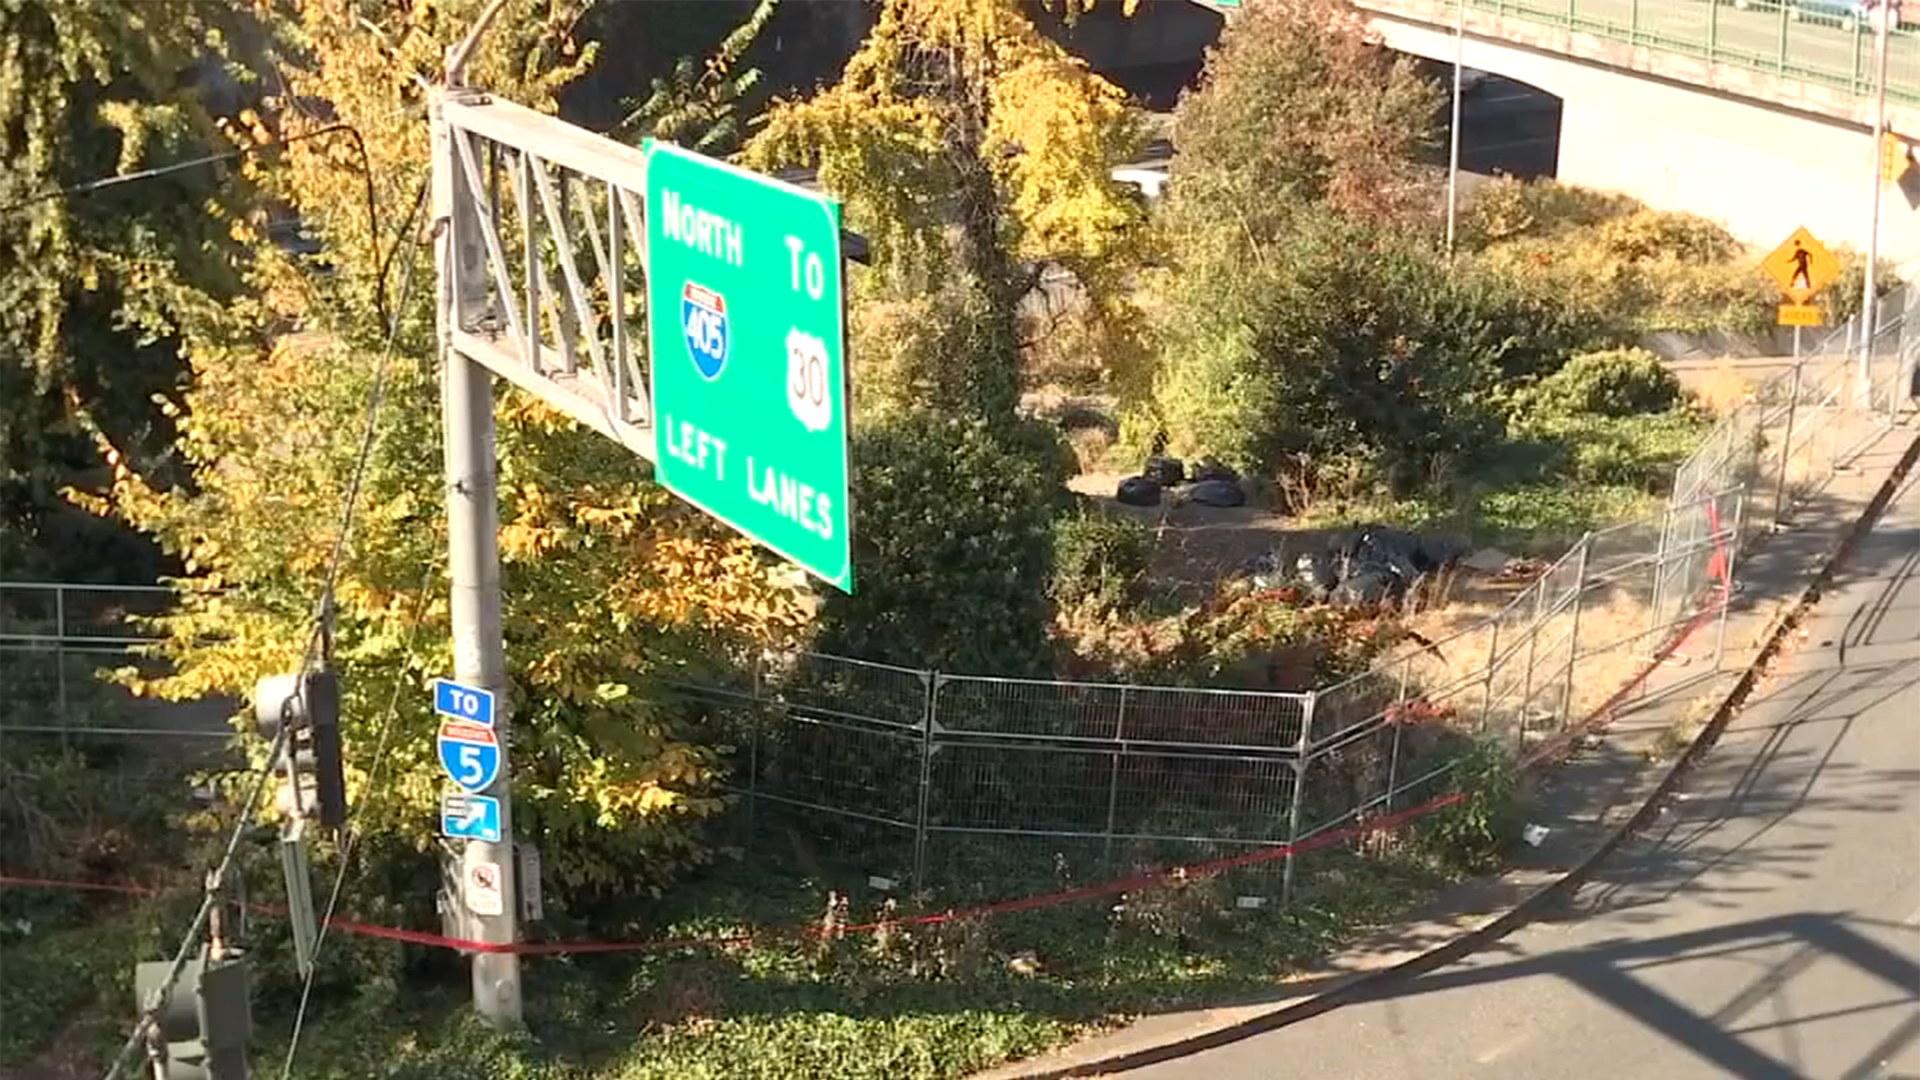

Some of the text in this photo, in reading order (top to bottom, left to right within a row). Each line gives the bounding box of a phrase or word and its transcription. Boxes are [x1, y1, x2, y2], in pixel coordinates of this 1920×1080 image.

[662, 187, 743, 267] NORTH
[785, 235, 824, 300] TO
[687, 307, 724, 360] 405
[793, 347, 823, 408] 30
[666, 413, 832, 540] LEFT LANES
[450, 690, 479, 715] TO
[460, 745, 483, 785] 5
